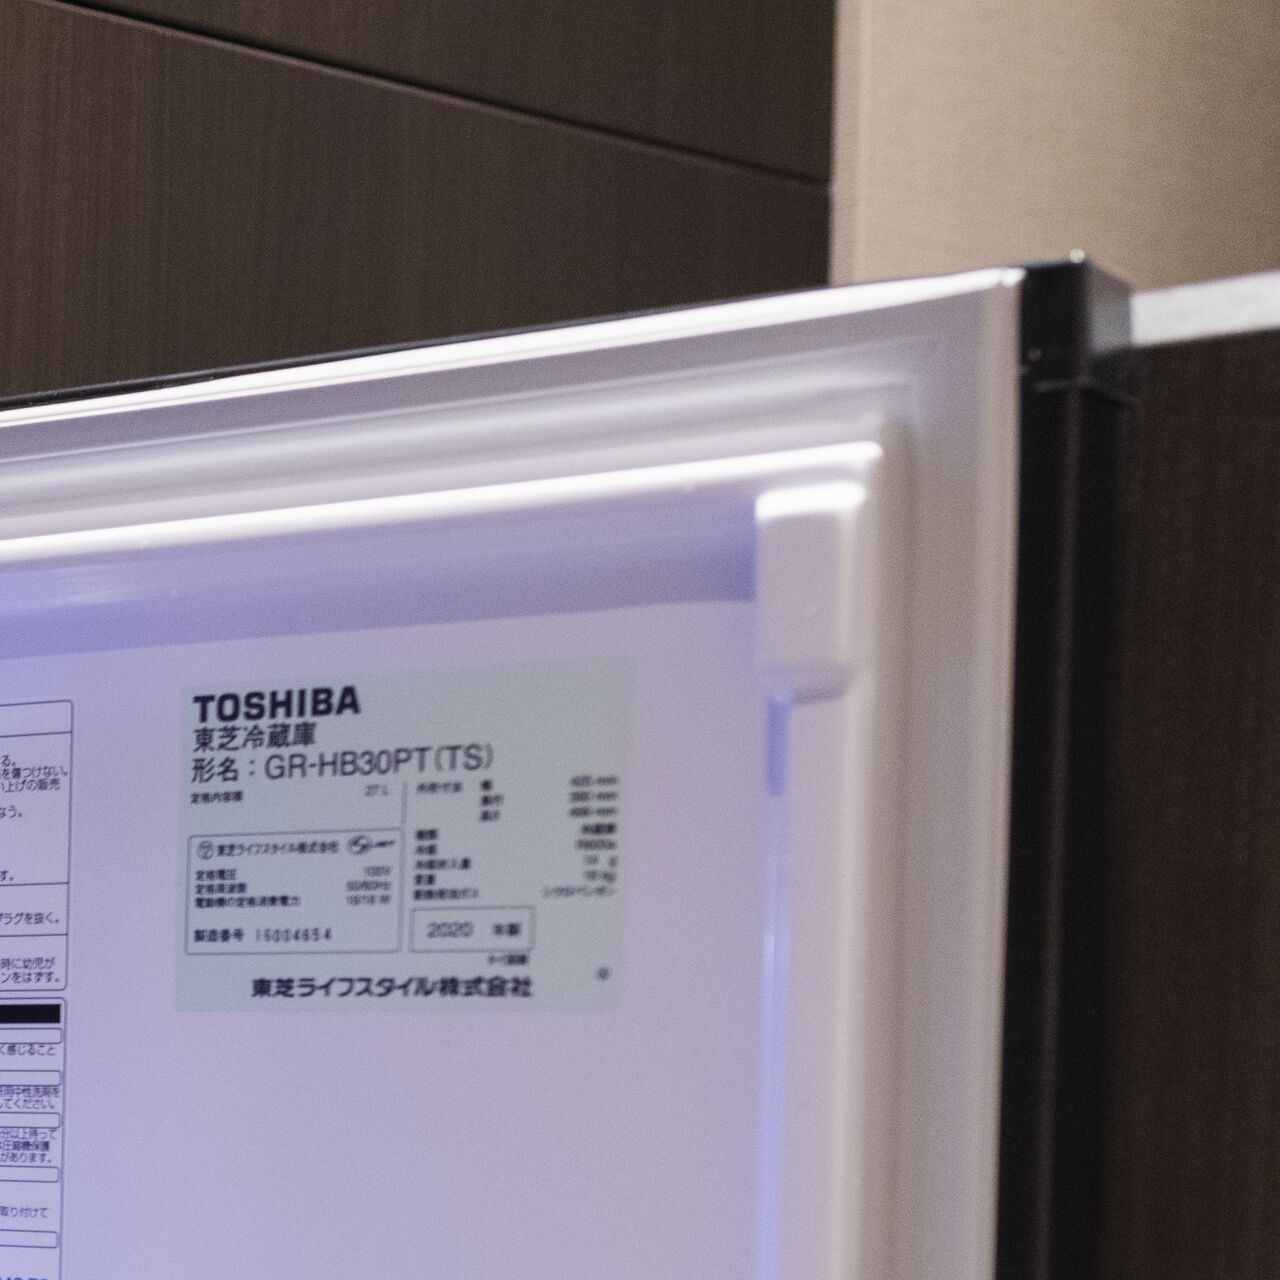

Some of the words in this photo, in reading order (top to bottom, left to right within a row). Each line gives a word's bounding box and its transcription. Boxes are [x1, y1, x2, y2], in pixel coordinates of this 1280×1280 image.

[193, 685, 361, 724] TOSHIBA
[192, 721, 317, 753] 東芝冷蔵庫
[251, 975, 533, 998] 東芝ライフスタイル株式会社
